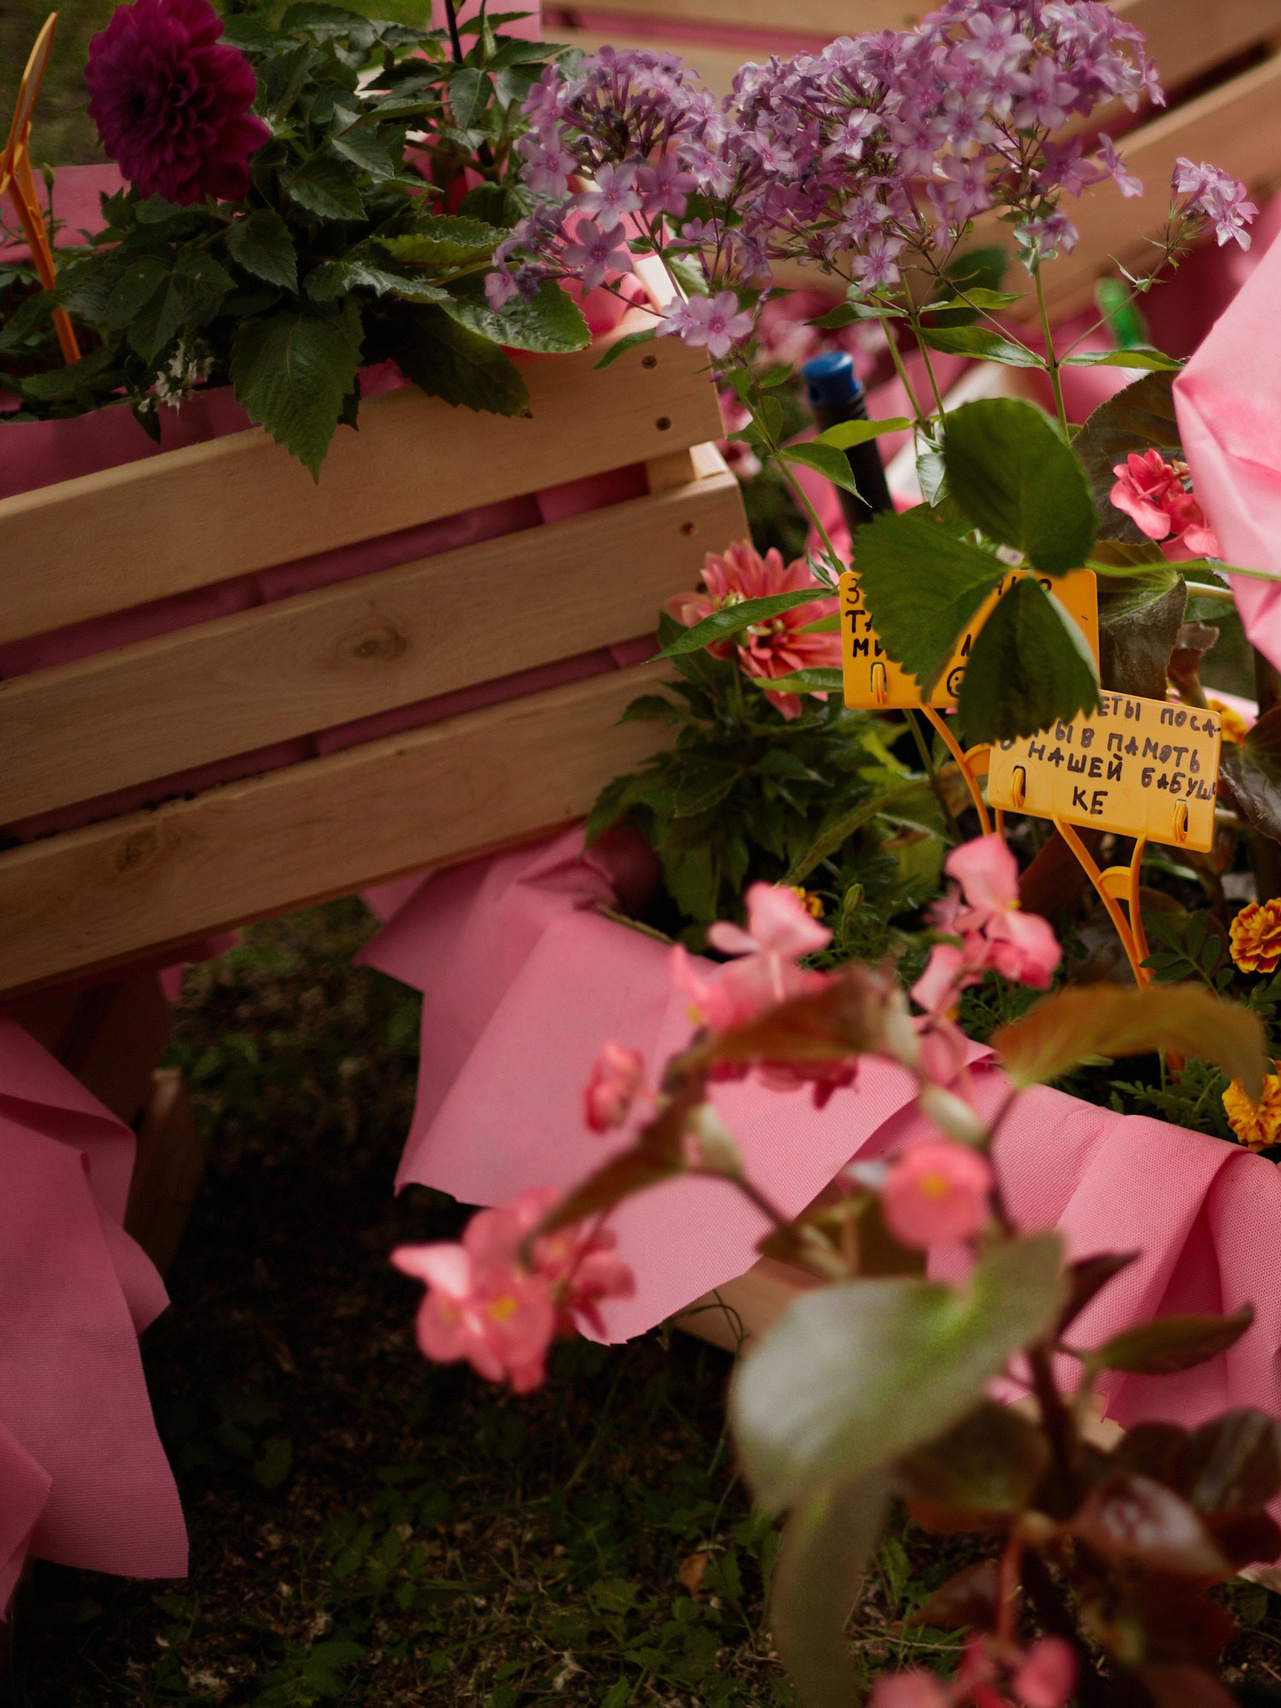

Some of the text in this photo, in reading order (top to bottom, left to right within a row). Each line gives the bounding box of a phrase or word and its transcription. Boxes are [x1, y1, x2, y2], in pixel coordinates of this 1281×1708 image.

[1097, 695, 1141, 722] ЕТЫ
[1080, 727, 1095, 749] В
[1028, 740, 1123, 782] НАШЕЙ
[1072, 785, 1109, 816] КЕ
